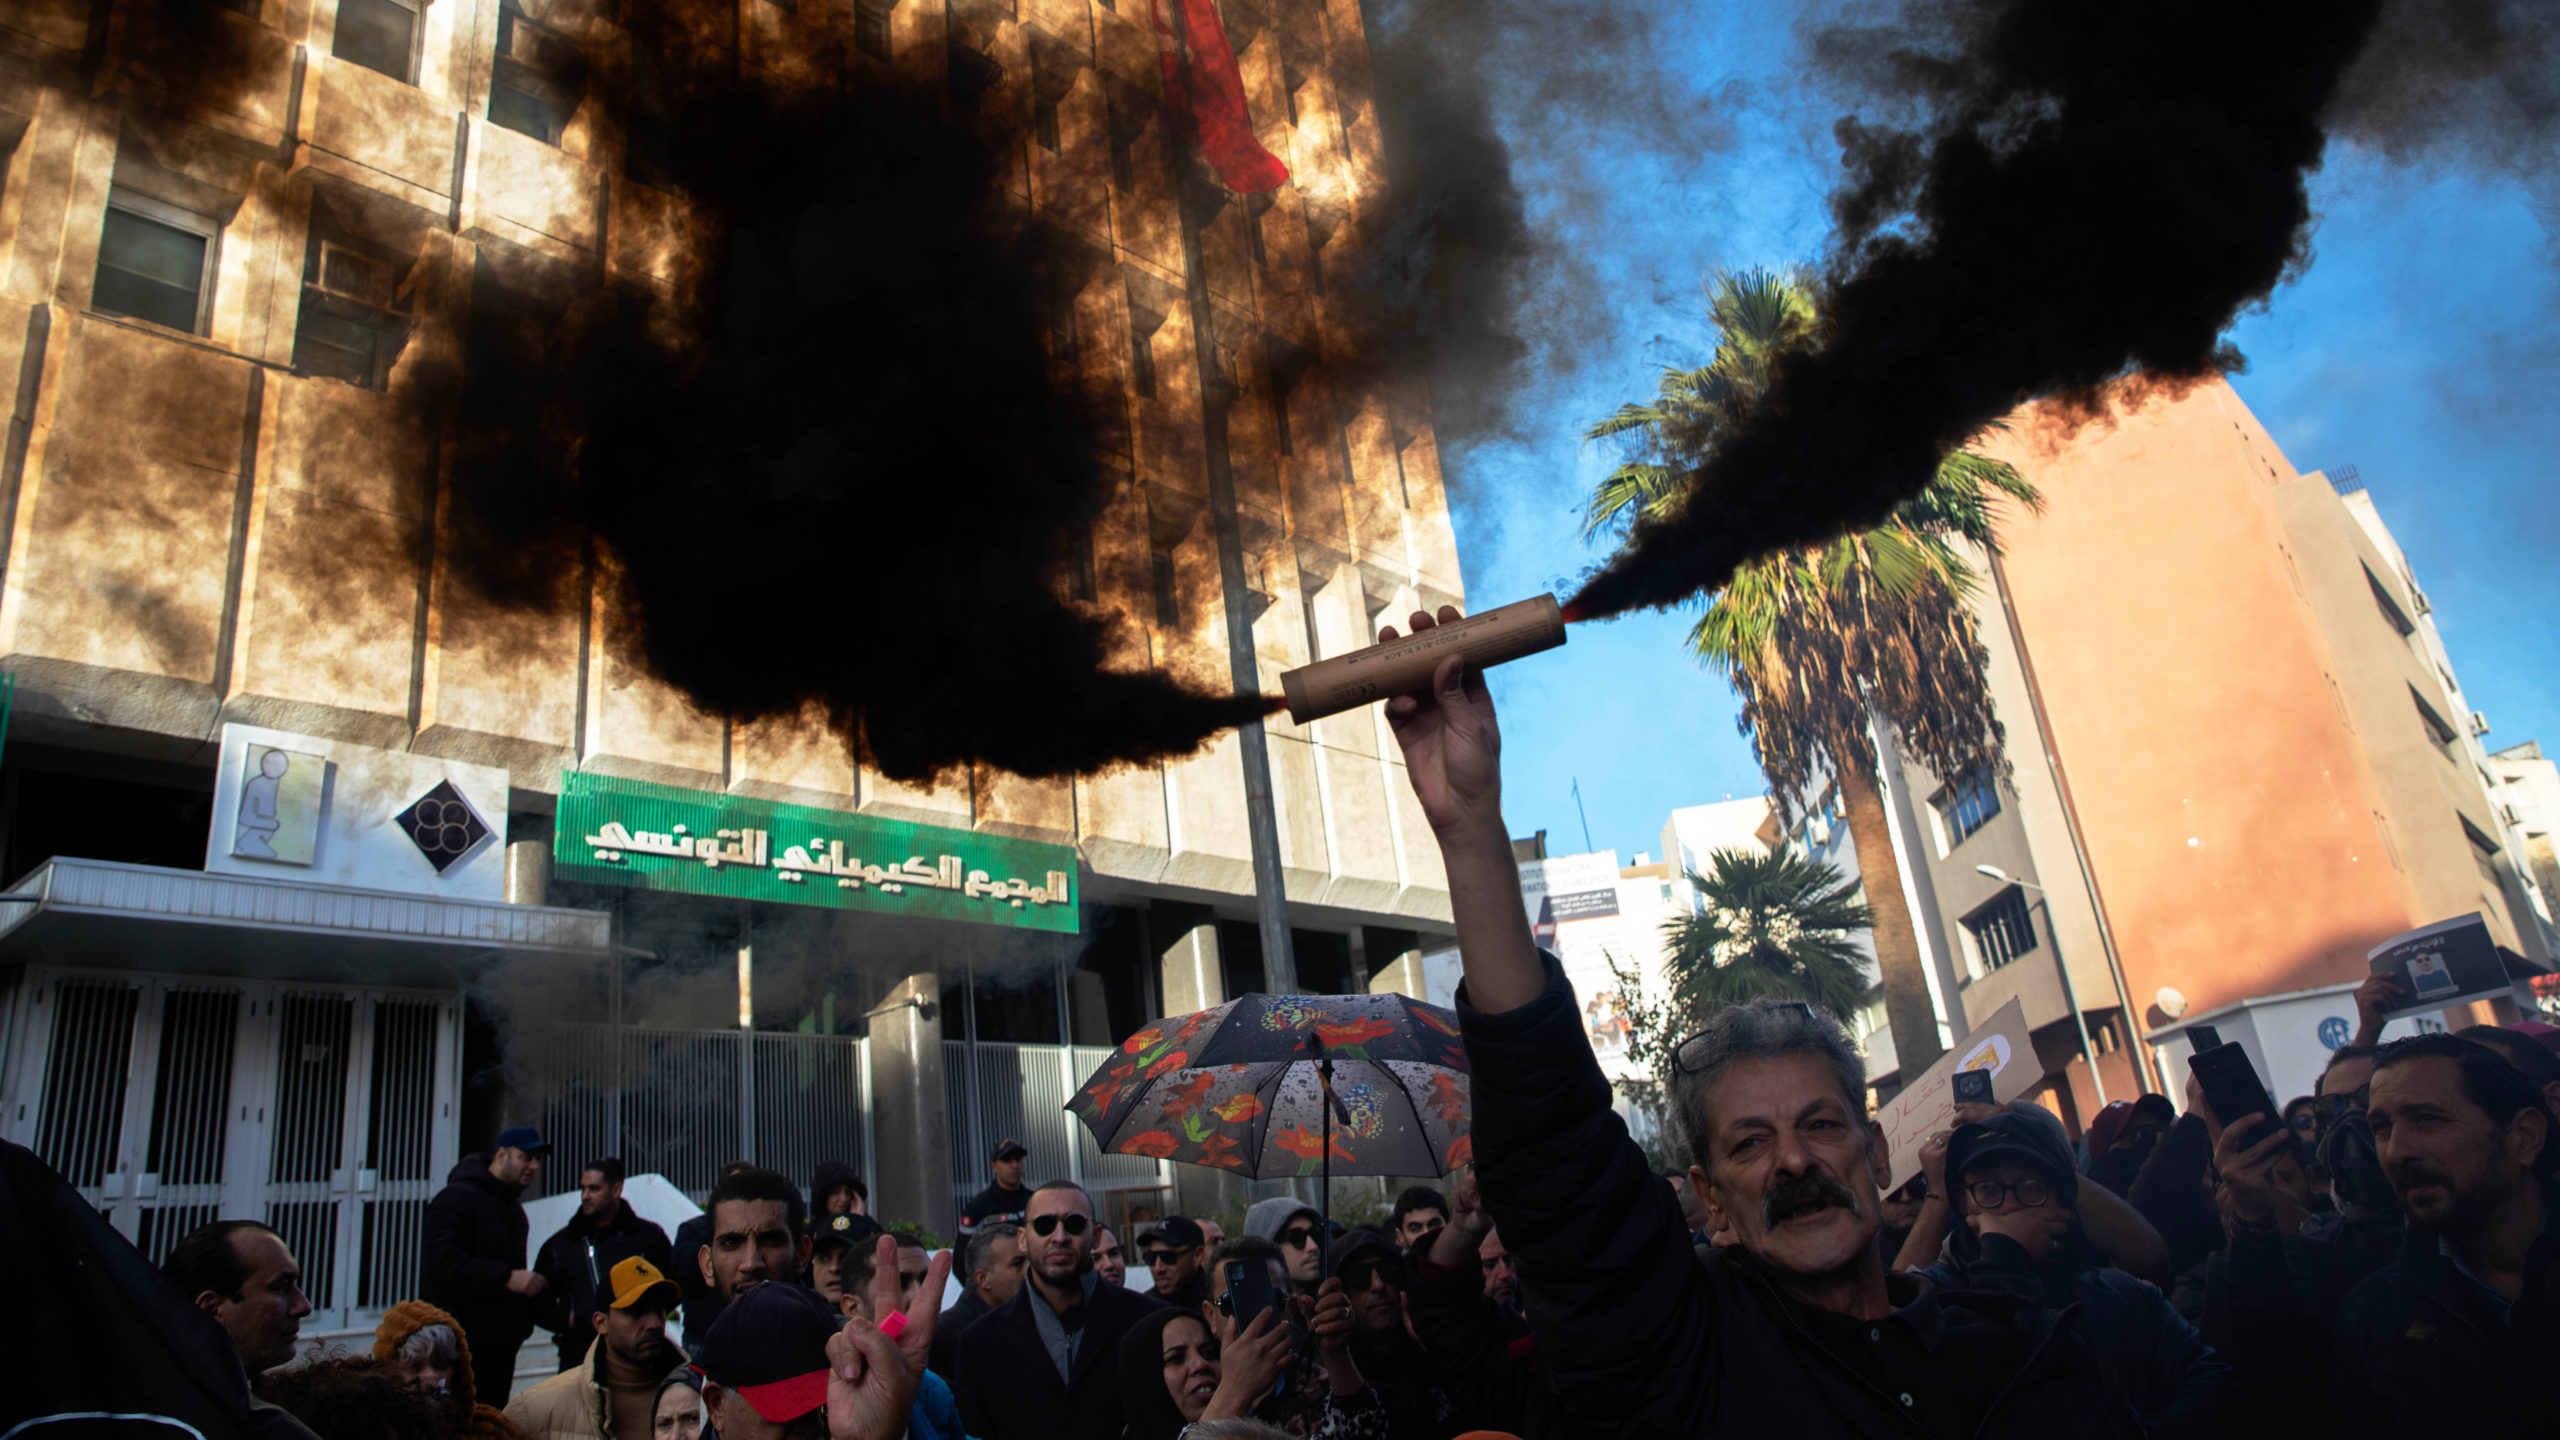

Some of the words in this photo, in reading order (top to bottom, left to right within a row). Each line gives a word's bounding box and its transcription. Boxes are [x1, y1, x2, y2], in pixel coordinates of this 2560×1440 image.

[586, 821, 768, 868] التونسي
[772, 837, 962, 894] الكيميائي
[965, 870, 1068, 908] المجمع
